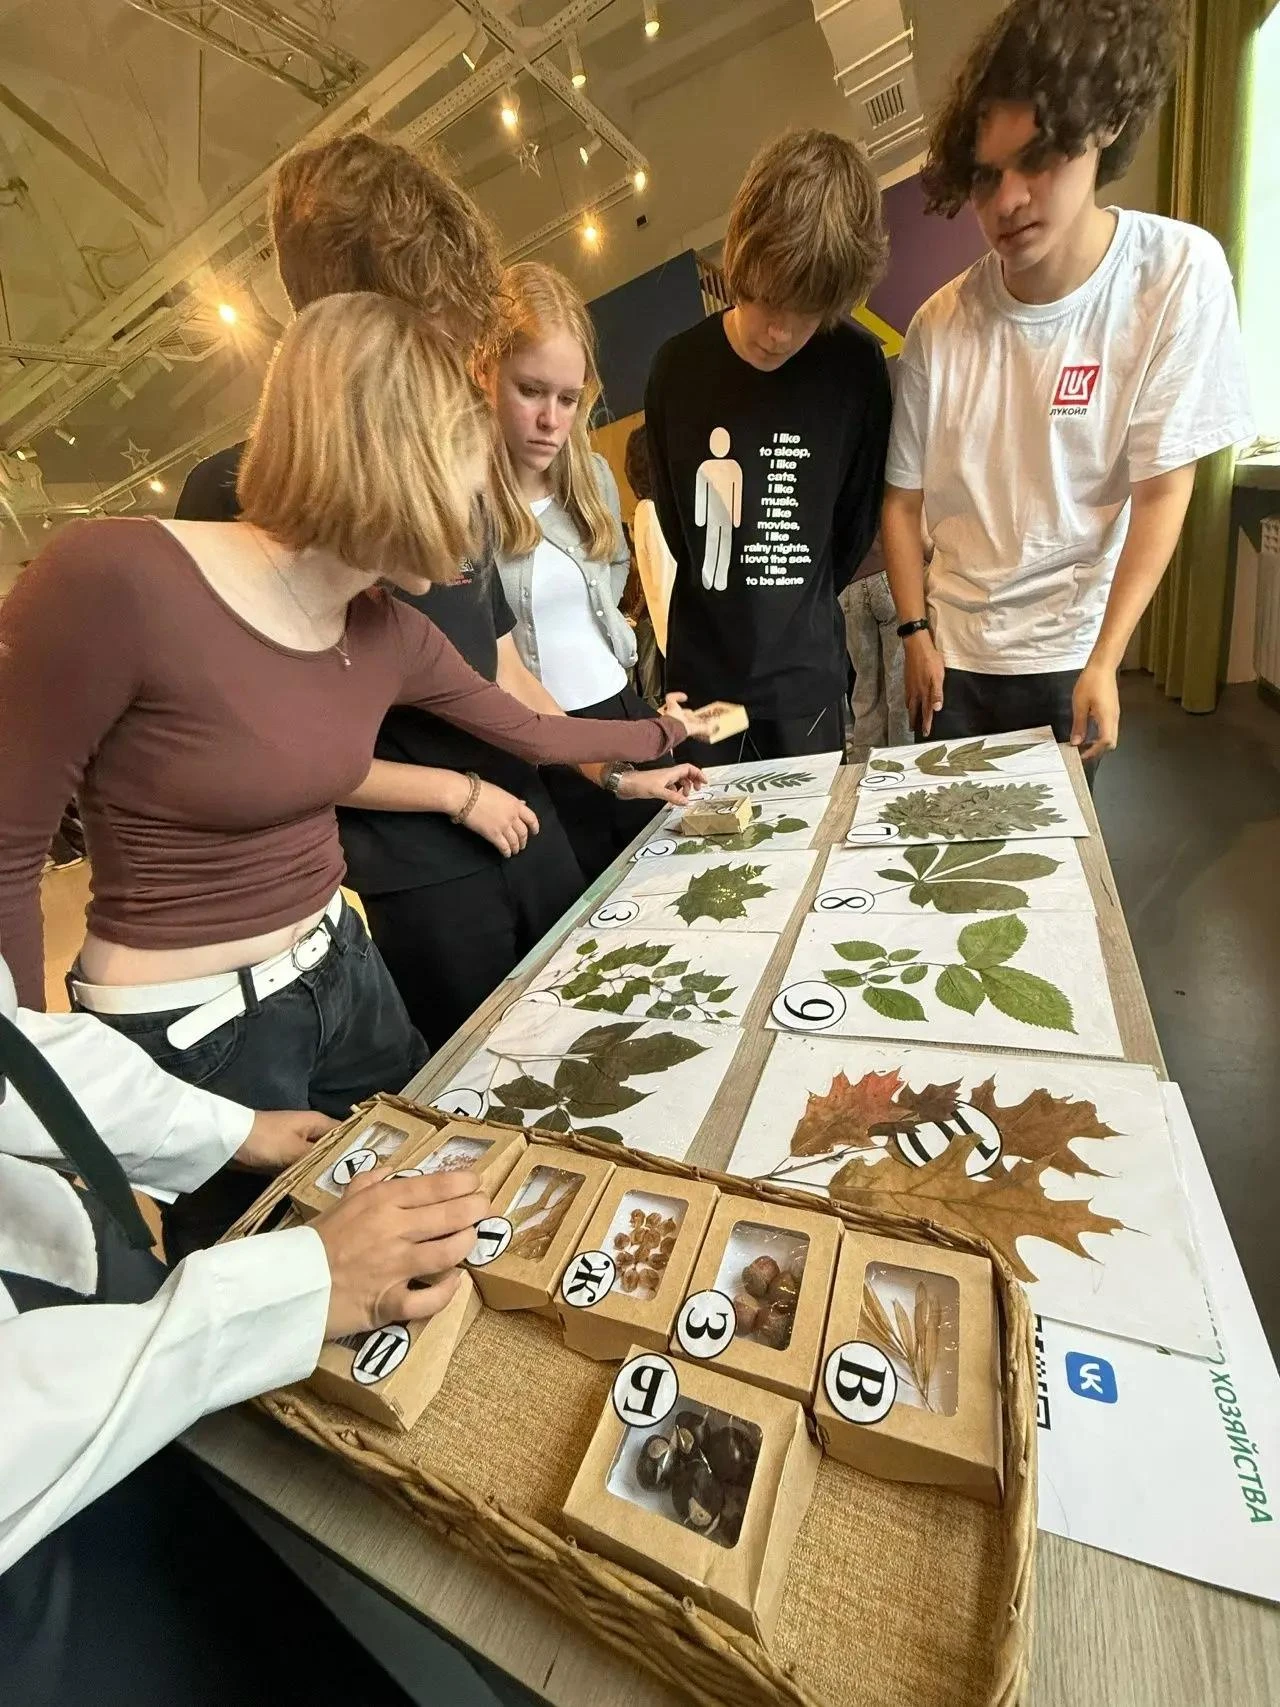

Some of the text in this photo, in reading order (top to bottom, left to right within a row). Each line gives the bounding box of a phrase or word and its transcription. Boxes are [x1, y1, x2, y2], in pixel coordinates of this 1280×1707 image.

[1049, 406, 1088, 416] ЛУКОЙЛ
[773, 433, 801, 444] I like
[759, 446, 811, 458] to sleep,
[770, 459, 797, 469] I like
[767, 473, 797, 482] cats,
[768, 484, 794, 494] I like
[761, 496, 799, 507] music,
[766, 508, 792, 518] I like
[757, 519, 800, 531] movies,
[765, 531, 790, 541] I like
[743, 543, 810, 554] rainy nights,
[740, 554, 744, 563] I
[745, 554, 769, 563] love
[770, 554, 788, 563] the
[764, 565, 787, 574] I like
[745, 576, 804, 585] to be alone
[641, 846, 669, 856] 2
[820, 896, 867, 909] 8
[598, 908, 632, 921] 3
[344, 1153, 373, 1179] А
[566, 1255, 610, 1303] Ж
[354, 1331, 408, 1378] И
[835, 1352, 888, 1408] В
[622, 1365, 671, 1419] Б
[1209, 1368, 1274, 1523] ХОЗЯЙСТВА
